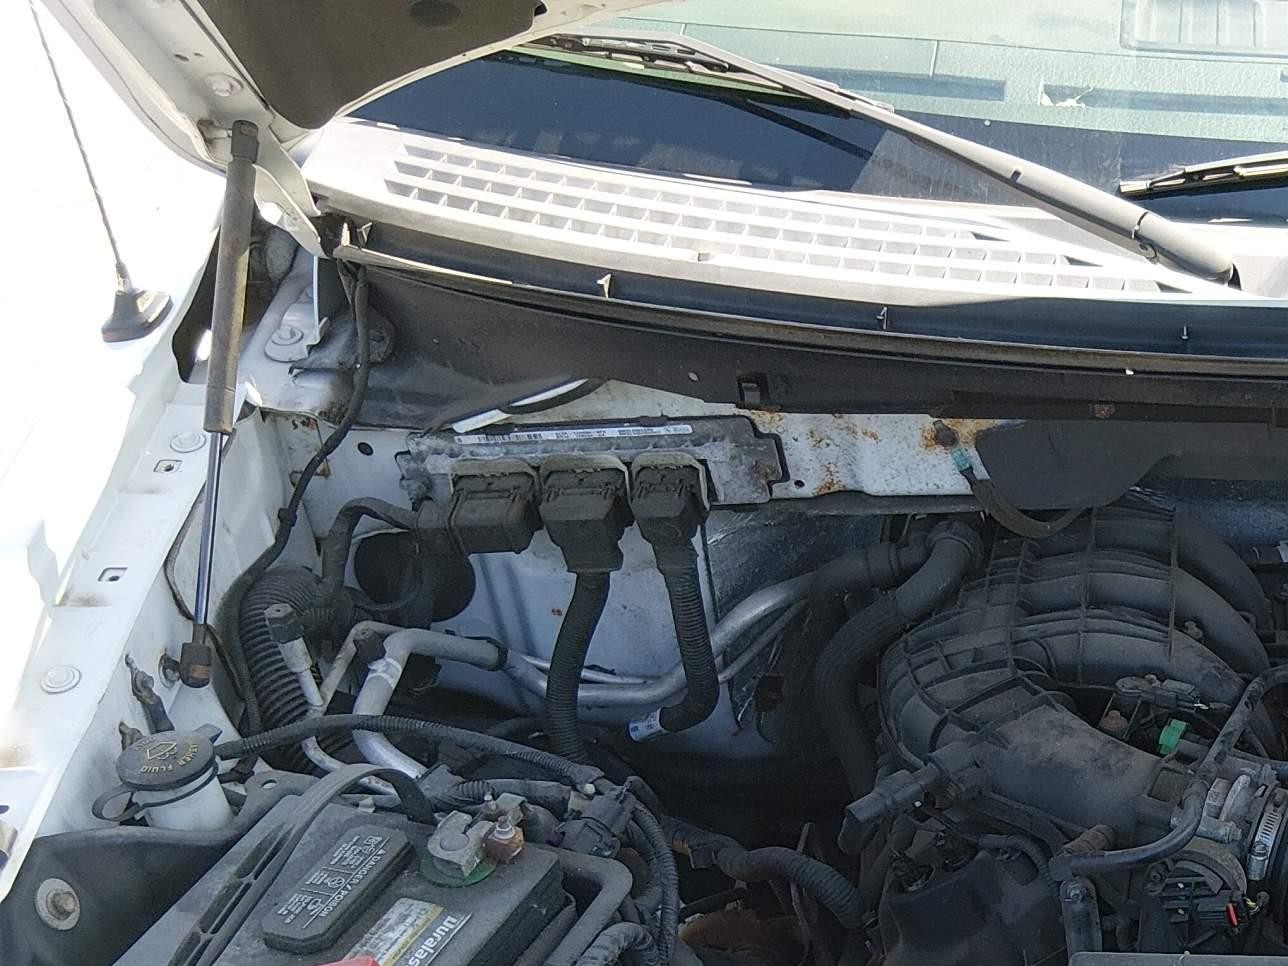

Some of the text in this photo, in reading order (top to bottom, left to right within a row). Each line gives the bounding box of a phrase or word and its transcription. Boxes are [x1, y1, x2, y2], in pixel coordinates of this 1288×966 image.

[140, 742, 199, 774] SHER FLUID
[351, 856, 381, 884] DANGER
[319, 889, 349, 917] POISON
